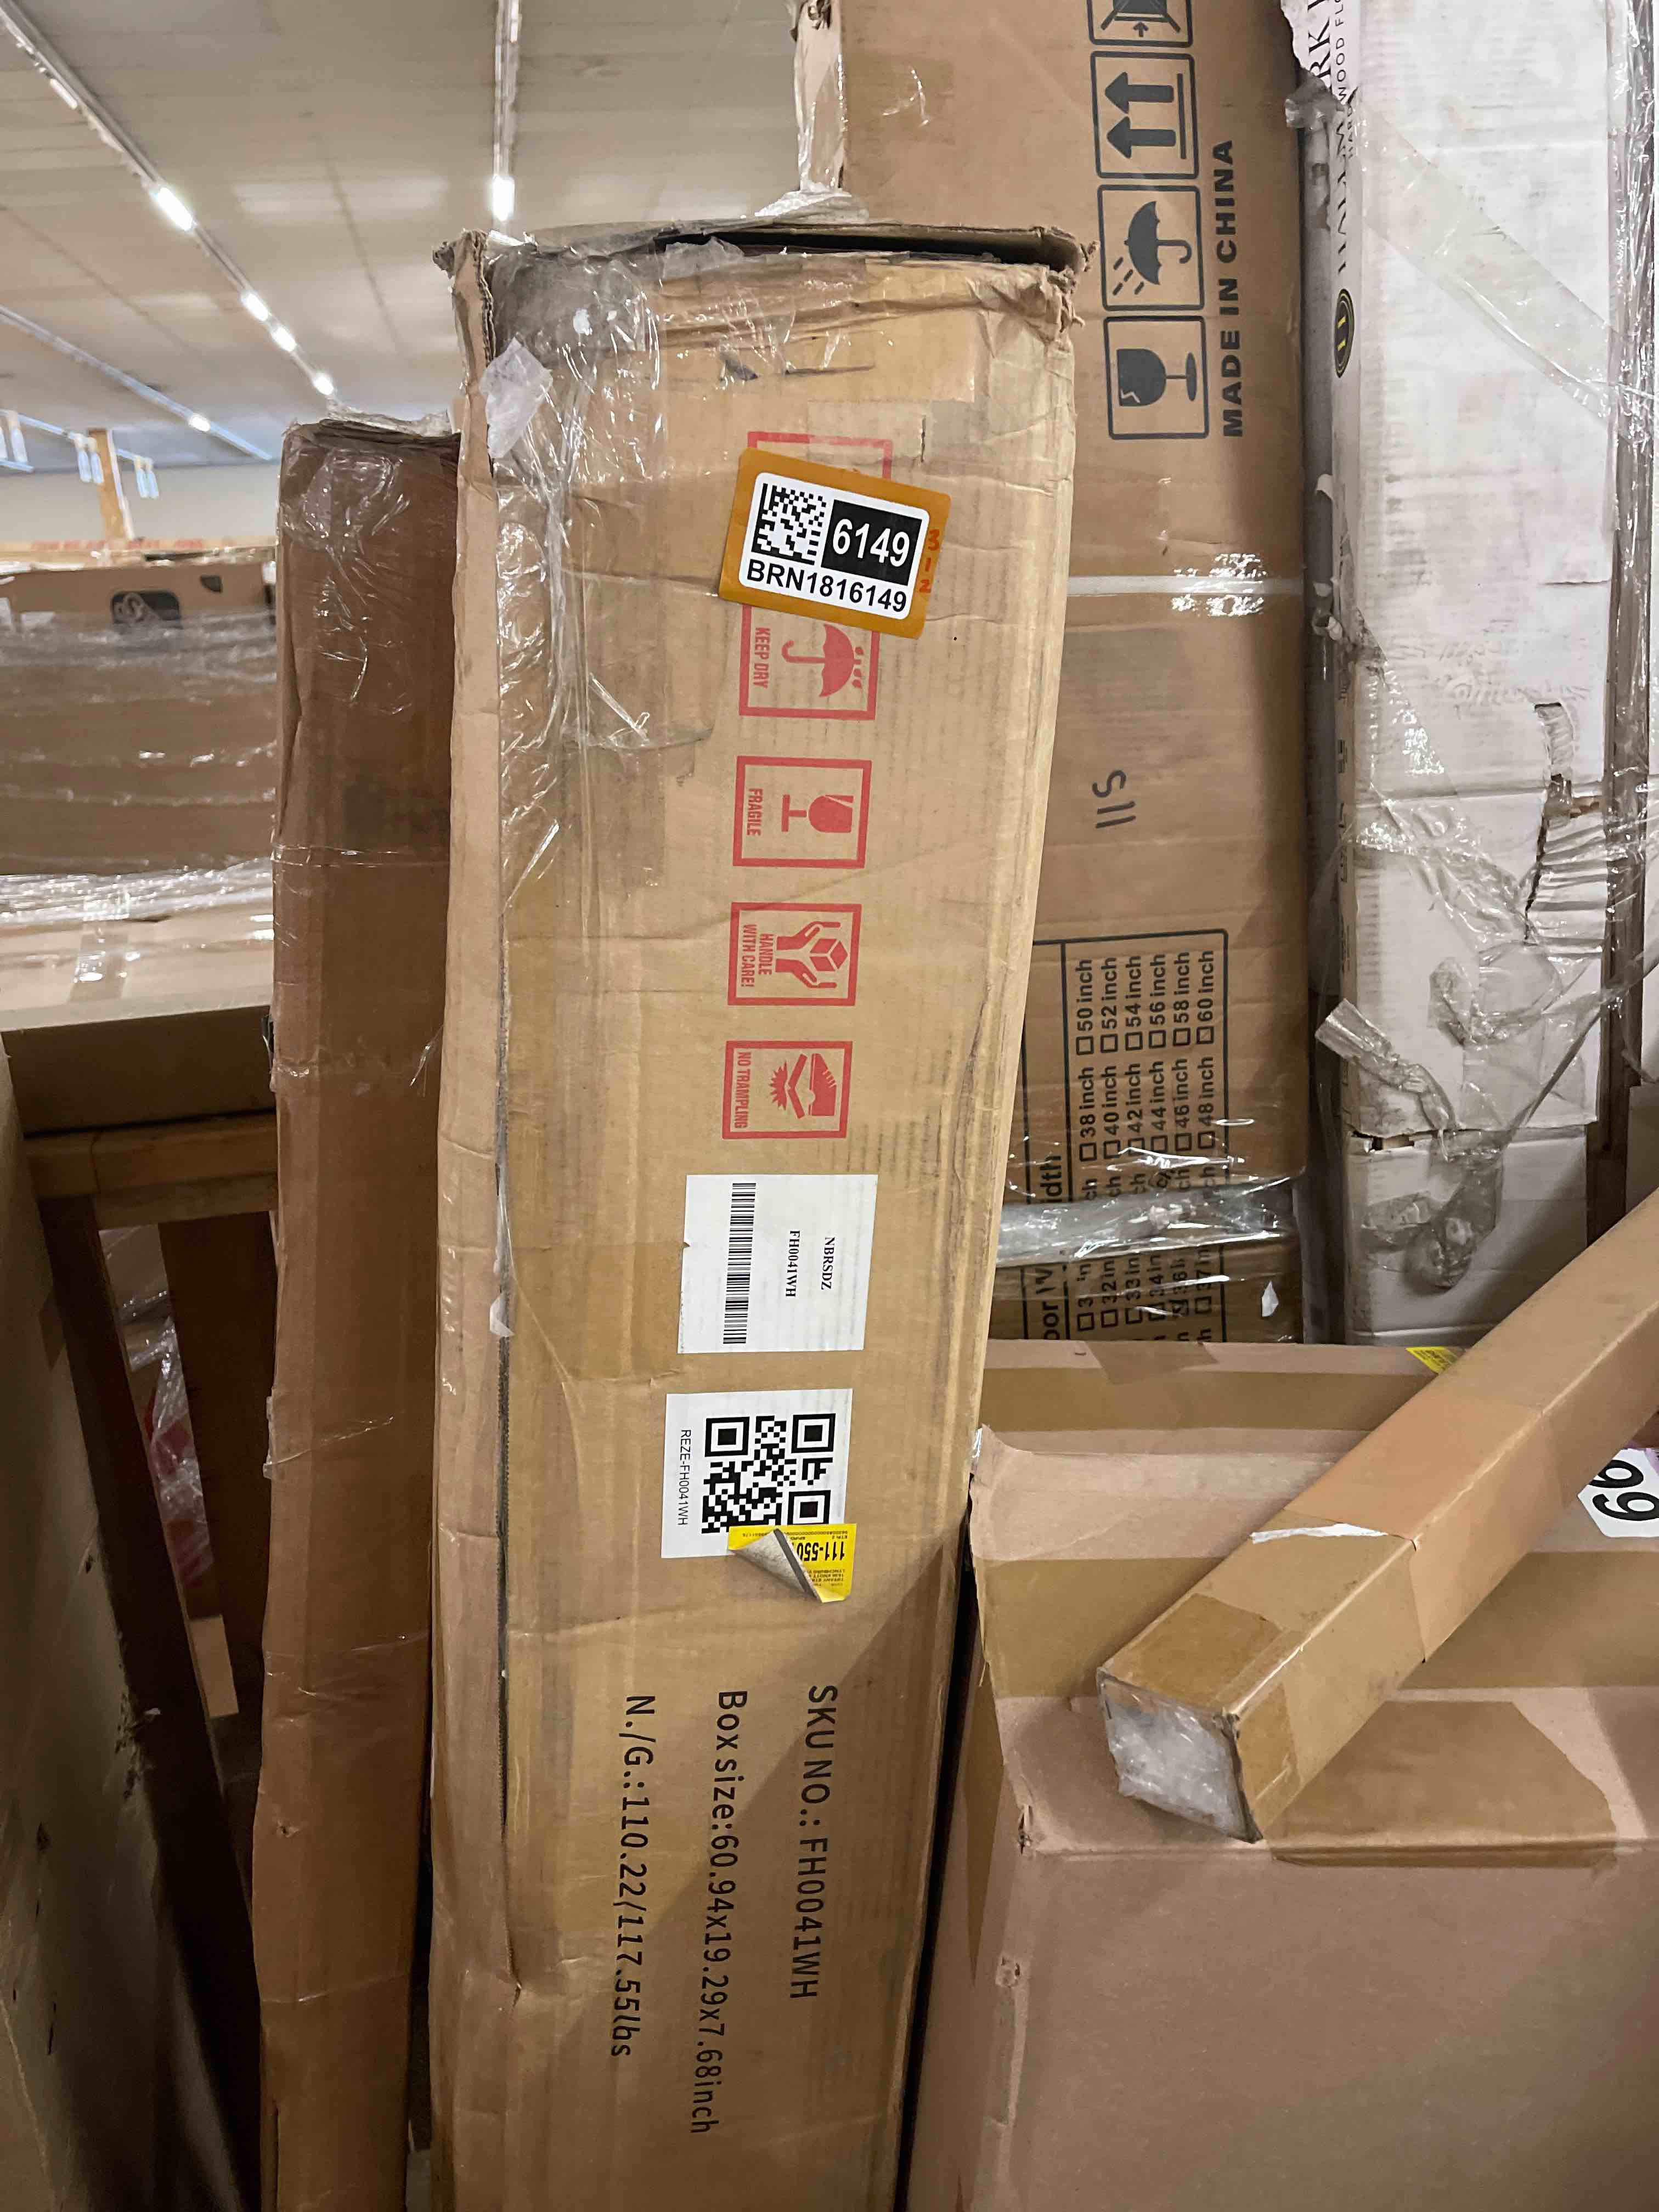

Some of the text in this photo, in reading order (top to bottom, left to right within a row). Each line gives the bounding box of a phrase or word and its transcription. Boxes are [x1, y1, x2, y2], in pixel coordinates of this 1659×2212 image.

[1308, 16, 1332, 95] RK
[1212, 140, 1243, 437] MADE IN CHINA
[832, 518, 910, 567] 6149
[747, 559, 907, 612] BRN1816149
[753, 627, 771, 689] KEEP DRY
[747, 788, 763, 837] FRAGILE
[741, 924, 757, 988] WITH CARE!
[758, 933, 774, 975] HANDLE
[1173, 952, 1189, 1023] 58 inch
[1197, 950, 1214, 1022] 60 inch
[1075, 960, 1093, 1031] 50 inch
[1101, 957, 1118, 1029] 52 inch
[1125, 955, 1141, 1027] 54 inch
[1150, 954, 1165, 1025] 56 inch
[734, 1052, 751, 1129] NO TRAMPLING
[1079, 1067, 1096, 1138] 38 inch
[1102, 1065, 1119, 1136] 40 inch
[1125, 1063, 1142, 1133] 42 inch
[1149, 1061, 1166, 1130] 44 inch
[1172, 1058, 1189, 1128] 46 inch
[1198, 1056, 1214, 1126] 48 inch
[786, 1230, 800, 1297] FH0041WH
[821, 1237, 834, 1289] NBRSDZ
[1126, 1278, 1141, 1300] 33
[678, 1429, 691, 1525] REZE-FH0041WH
[795, 1541, 845, 1561] 111-550
[716, 1691, 747, 1750] Box
[790, 1686, 838, 1998] SKU NO.: FH0041WH
